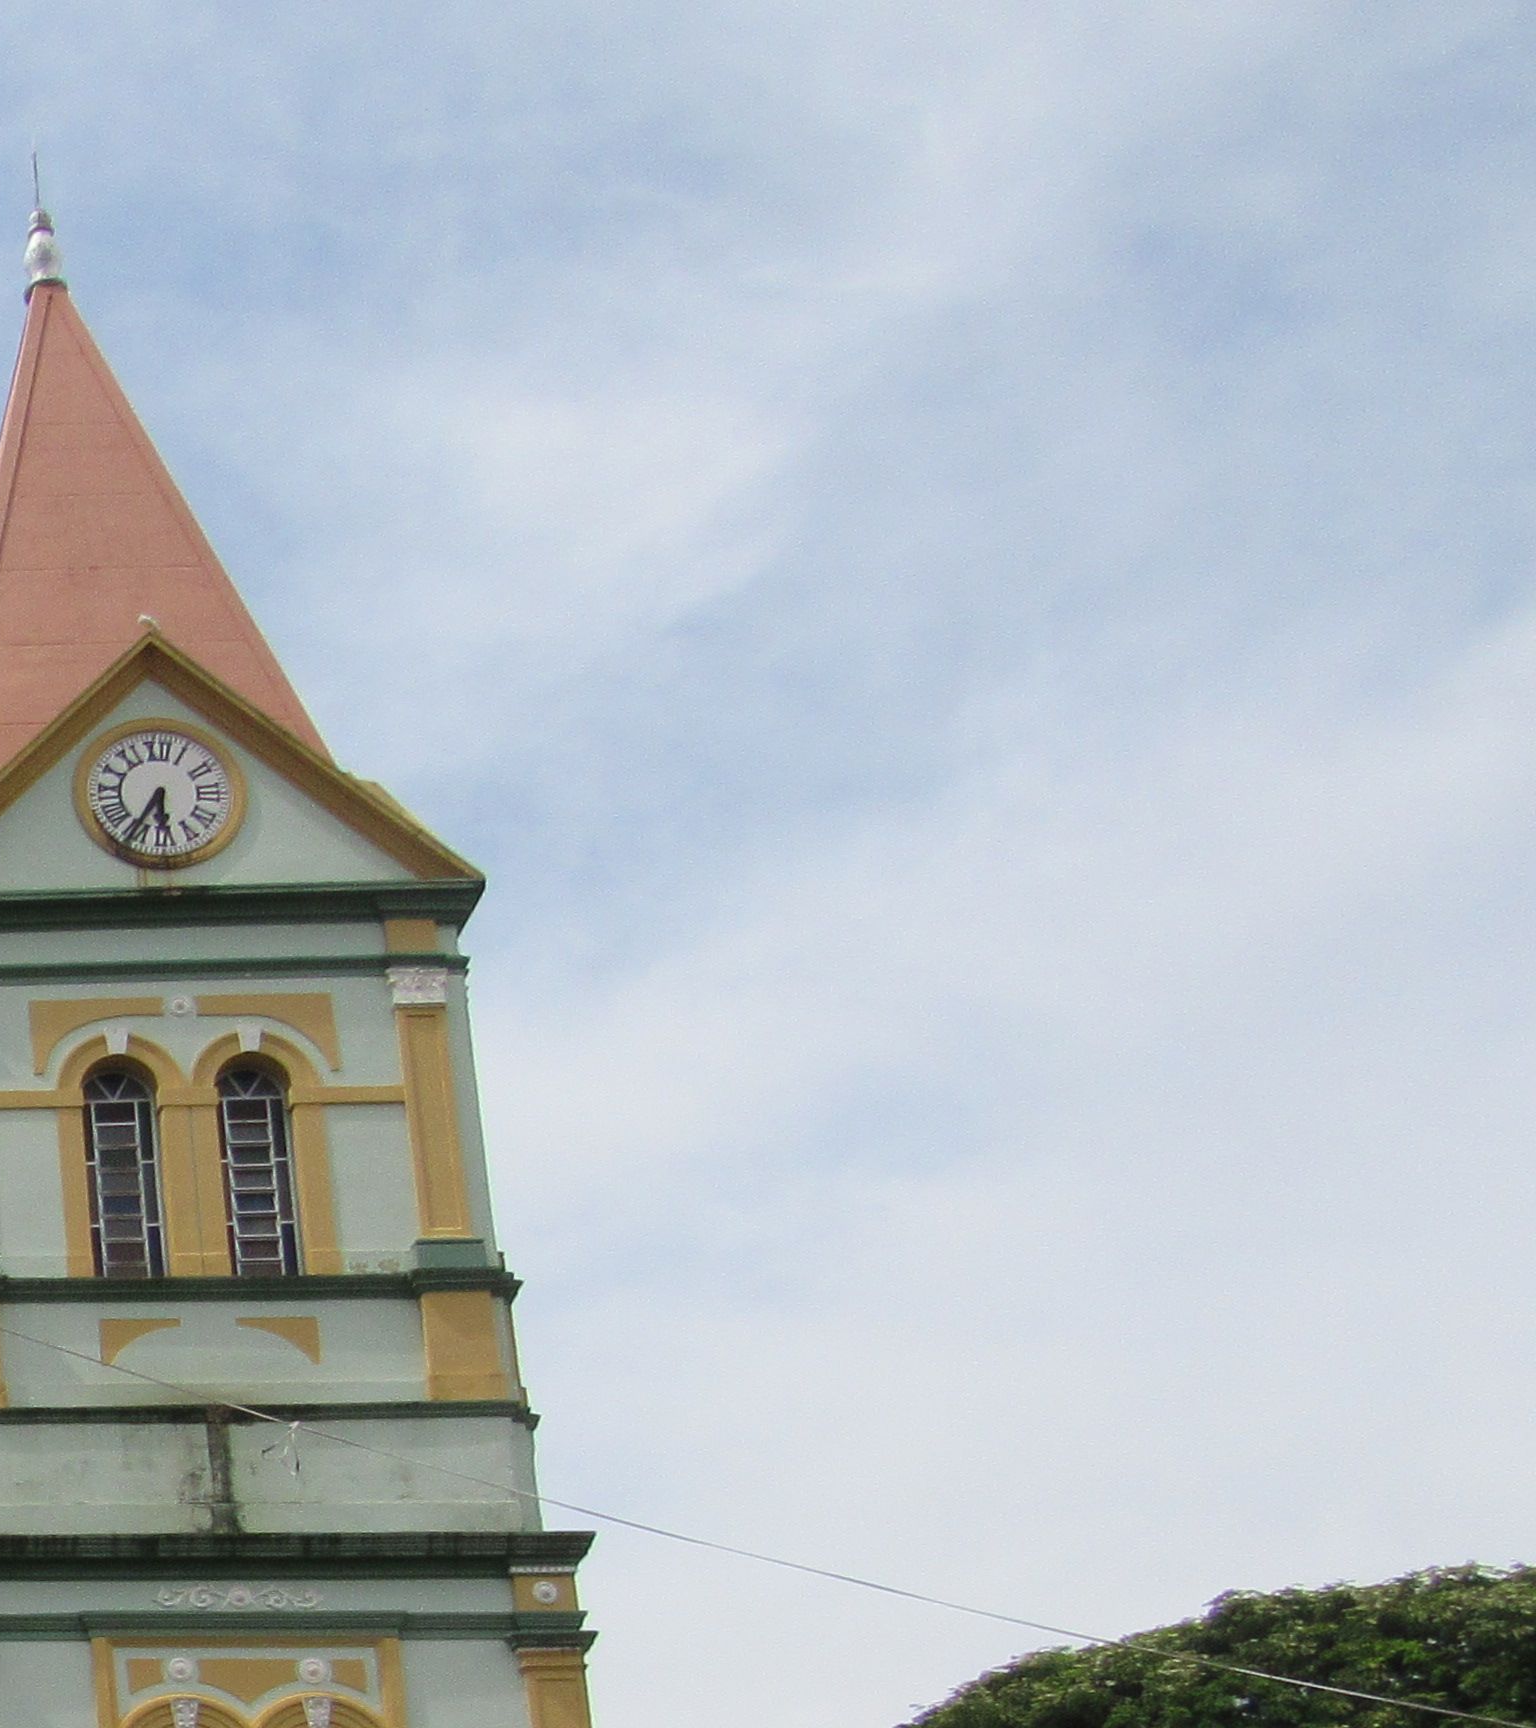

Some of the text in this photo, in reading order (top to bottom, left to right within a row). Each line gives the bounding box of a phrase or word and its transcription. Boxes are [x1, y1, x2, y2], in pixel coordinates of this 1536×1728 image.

[115, 745, 144, 768] XI
[143, 741, 171, 762] XII
[173, 744, 188, 766] I
[102, 764, 127, 779] X
[188, 761, 212, 780] II
[97, 783, 123, 801] IX
[196, 782, 221, 802] III
[101, 802, 132, 828] VIII
[190, 805, 216, 828] IV
[178, 820, 200, 842] V
